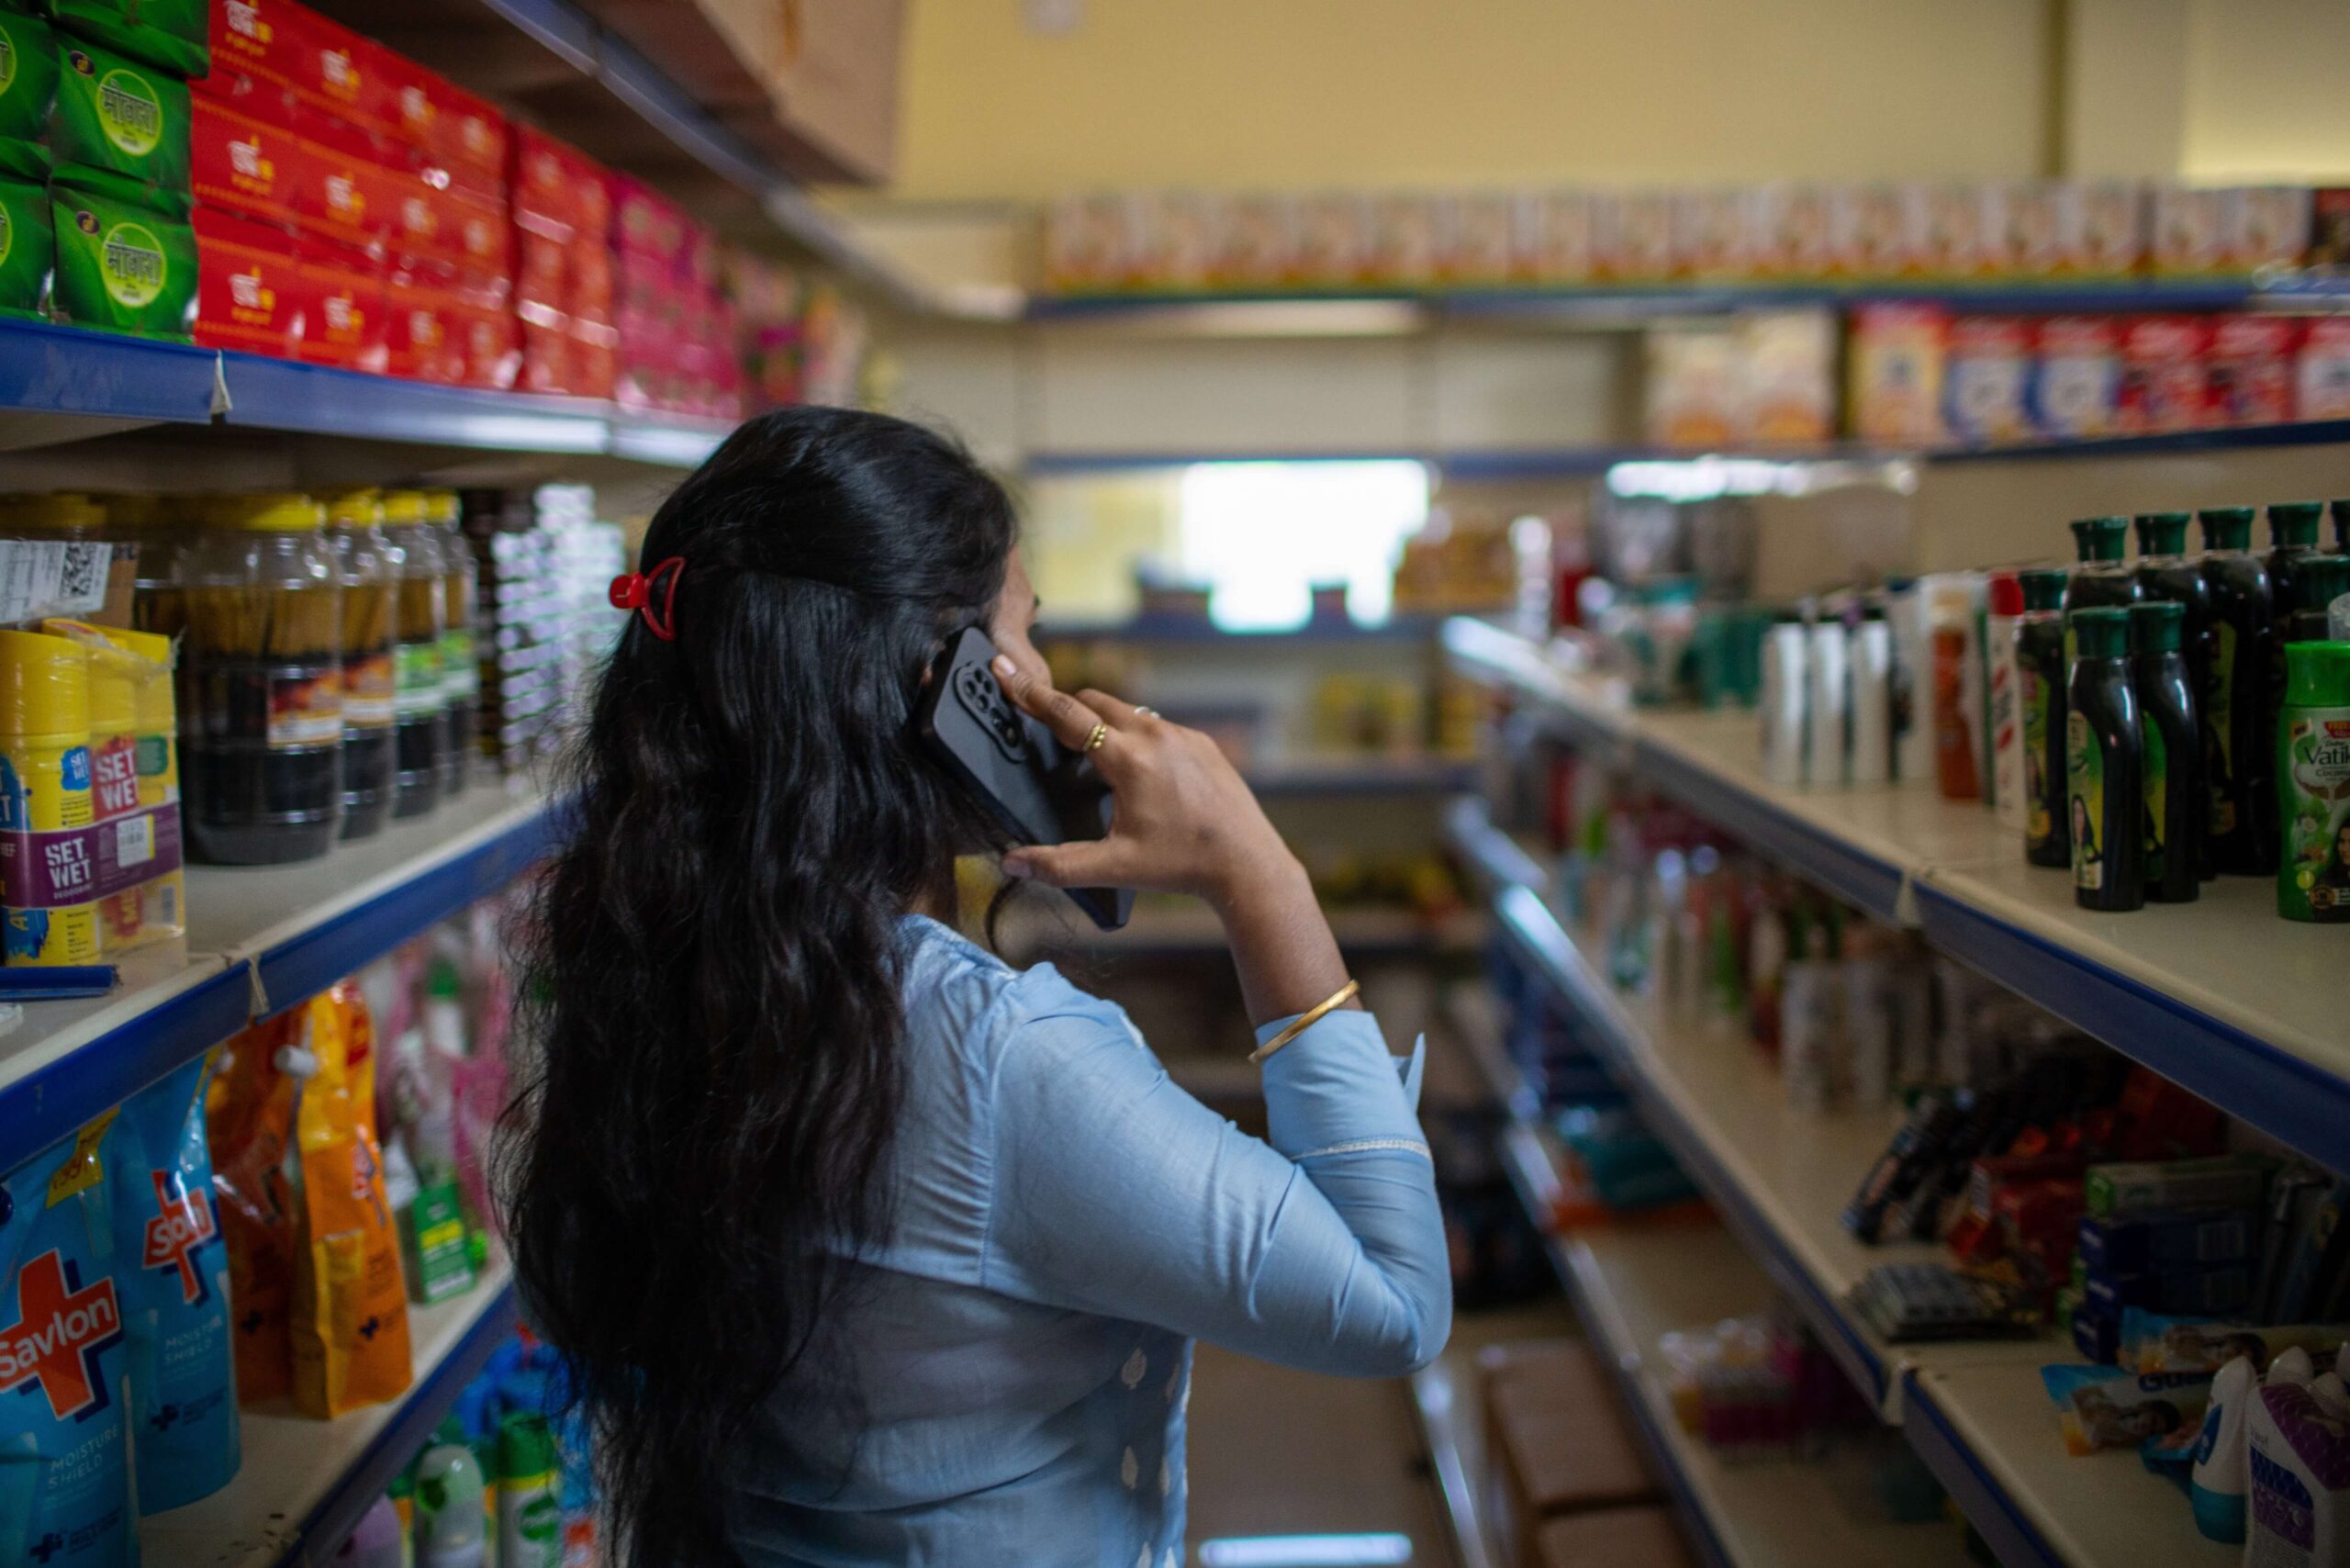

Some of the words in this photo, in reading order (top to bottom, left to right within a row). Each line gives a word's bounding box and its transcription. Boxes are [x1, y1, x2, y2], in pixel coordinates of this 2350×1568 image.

[71, 752, 85, 767] SET
[95, 749, 134, 781] SET
[45, 837, 84, 866] SET
[50, 860, 91, 889] WET
[0, 1297, 113, 1377] Savlon
[51, 1424, 118, 1472] MOISTURE
[47, 1453, 103, 1490] SHIELD
